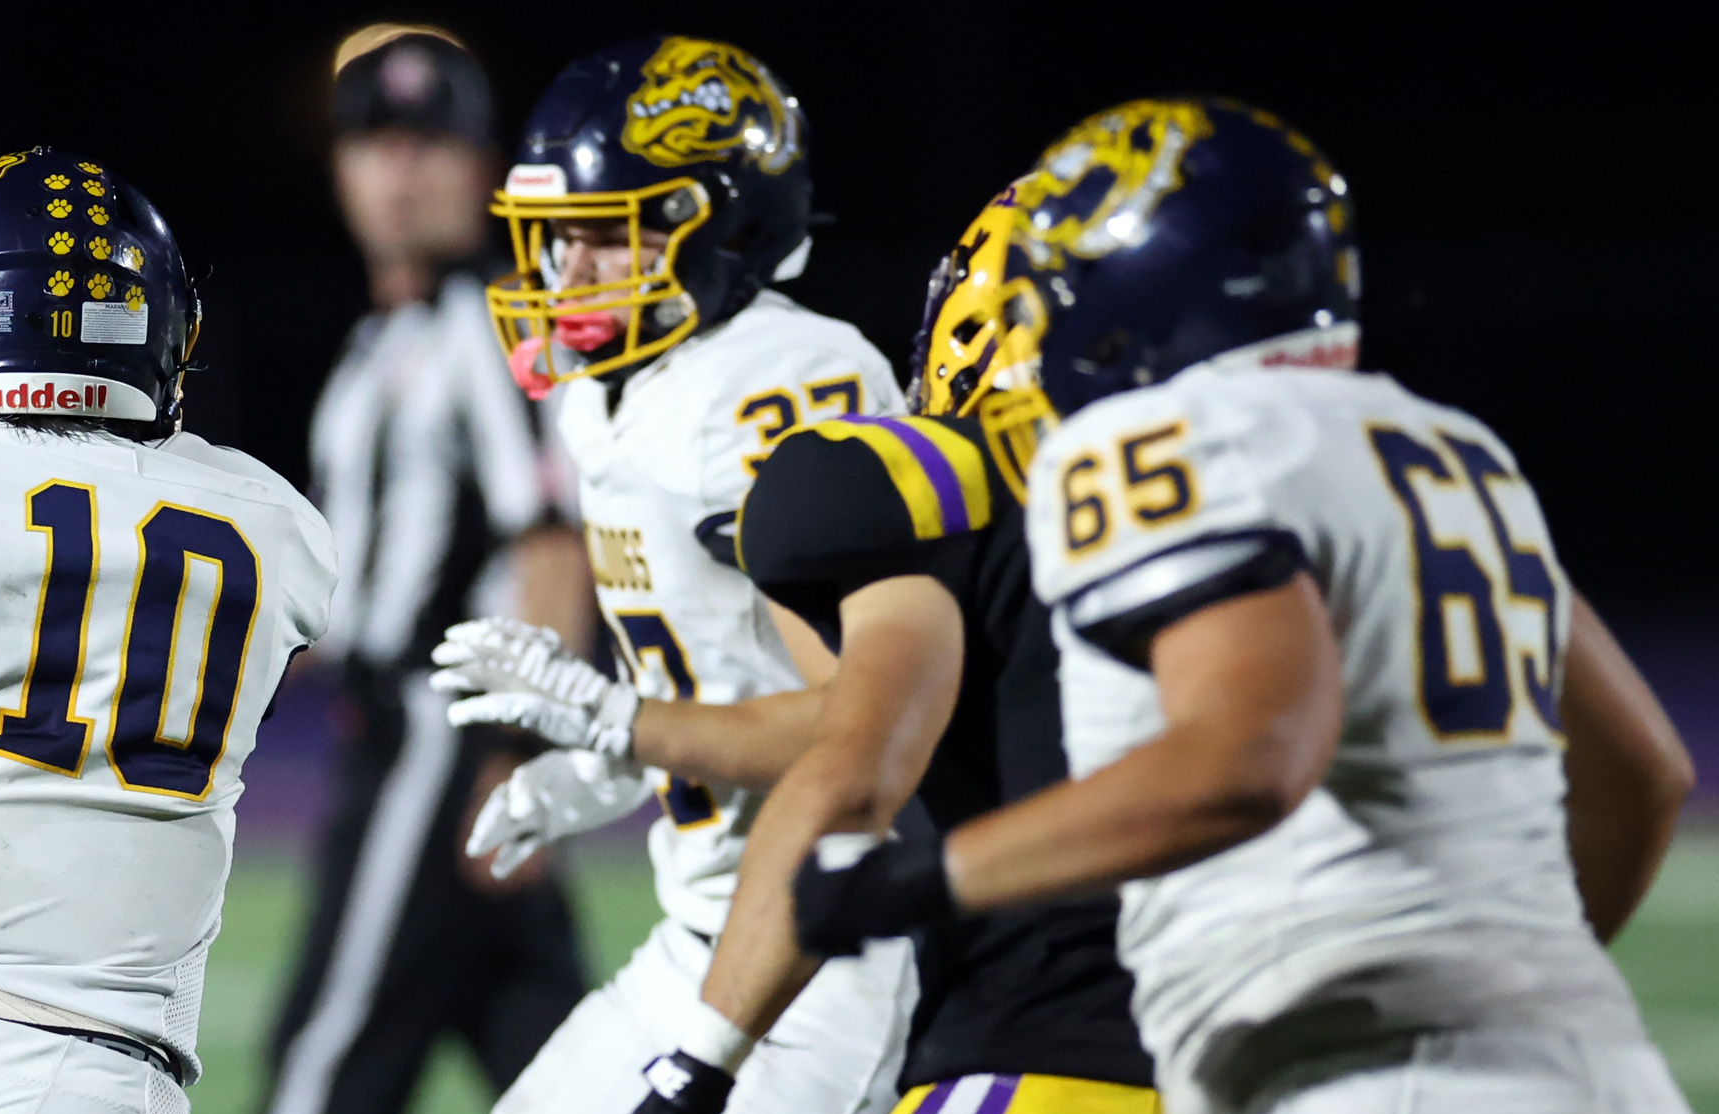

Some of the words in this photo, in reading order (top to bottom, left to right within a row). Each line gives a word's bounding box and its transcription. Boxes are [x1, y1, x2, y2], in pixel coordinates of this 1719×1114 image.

[50, 310, 72, 338] 10
[1058, 420, 1201, 562] 65
[1365, 420, 1569, 748] 65
